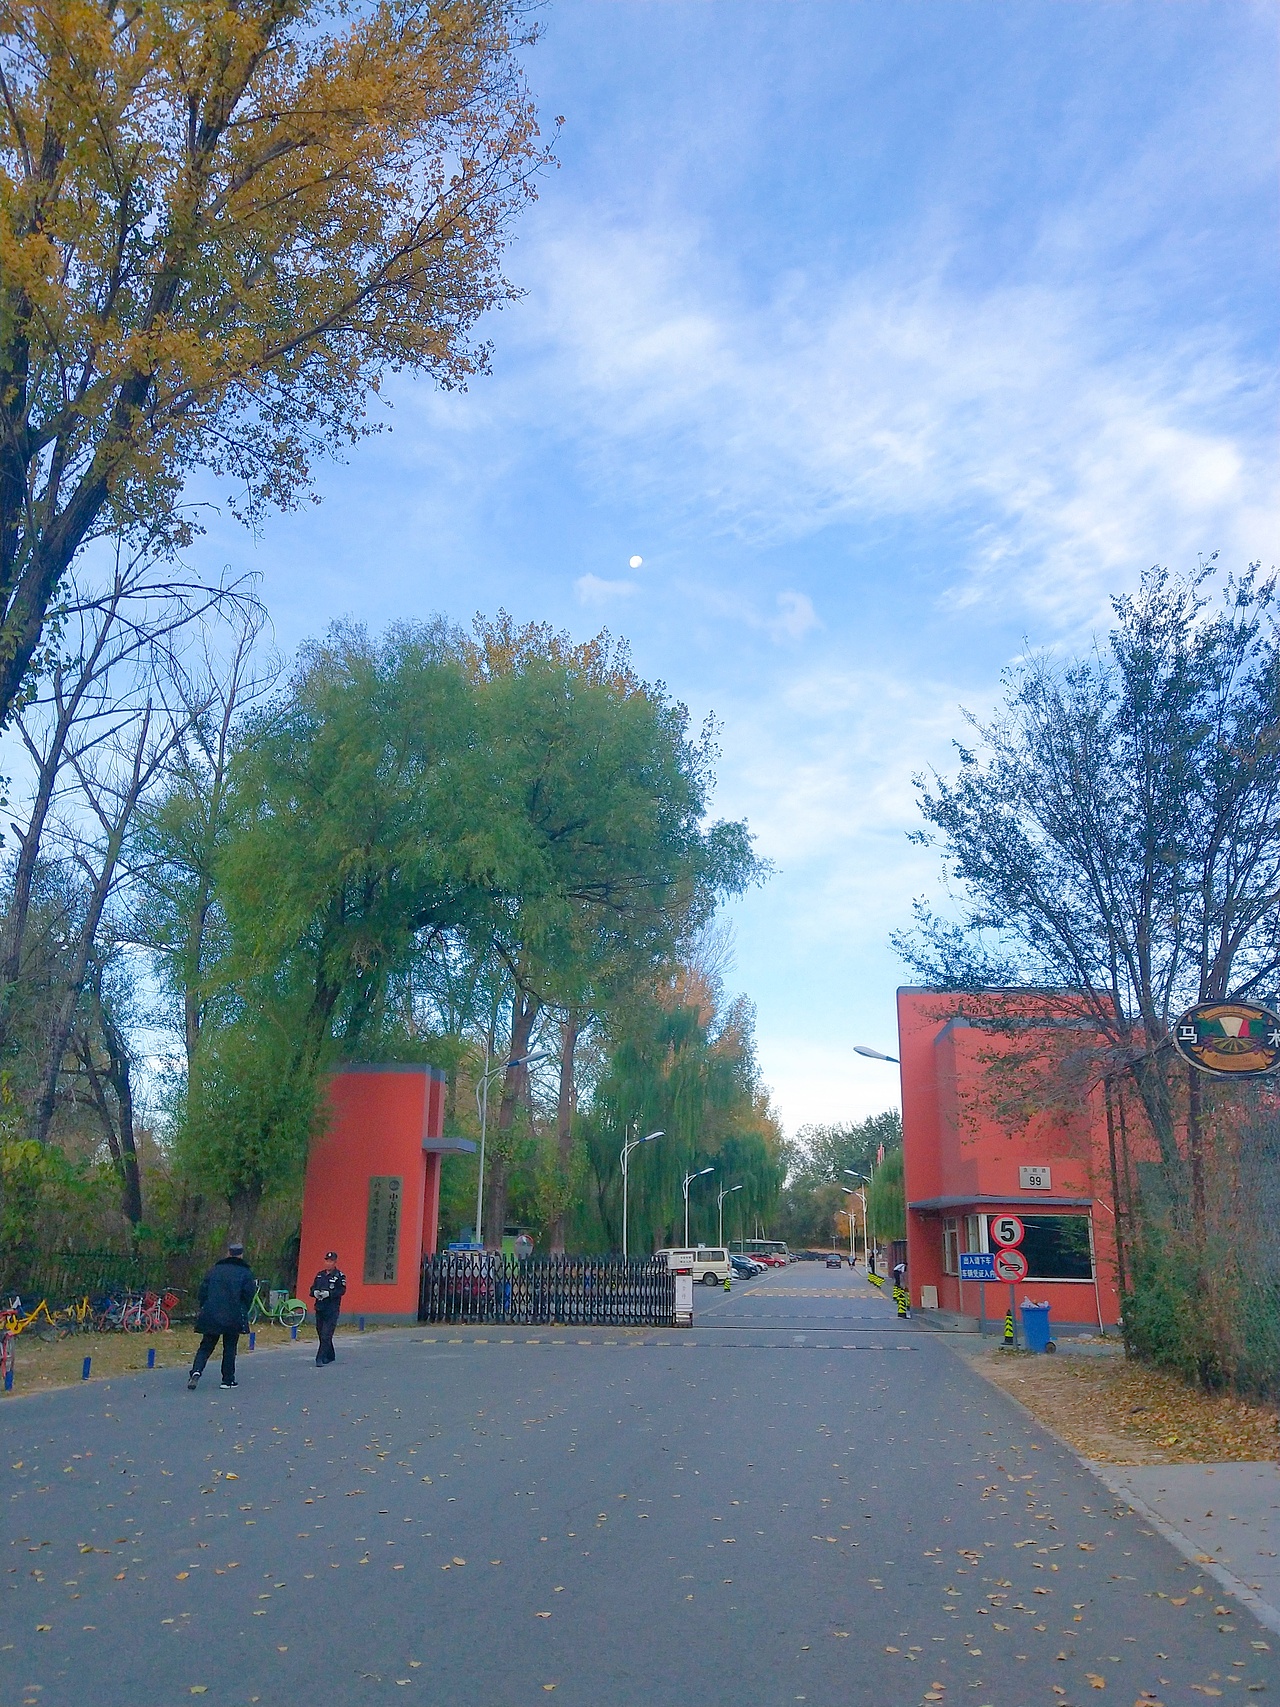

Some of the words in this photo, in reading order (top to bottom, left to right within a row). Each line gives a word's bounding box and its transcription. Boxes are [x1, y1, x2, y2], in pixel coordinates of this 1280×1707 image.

[1179, 1026, 1198, 1044] 马
[1029, 1176, 1042, 1186] 99
[1000, 1220, 1015, 1242] 5
[963, 1256, 992, 1265] 出入请下车
